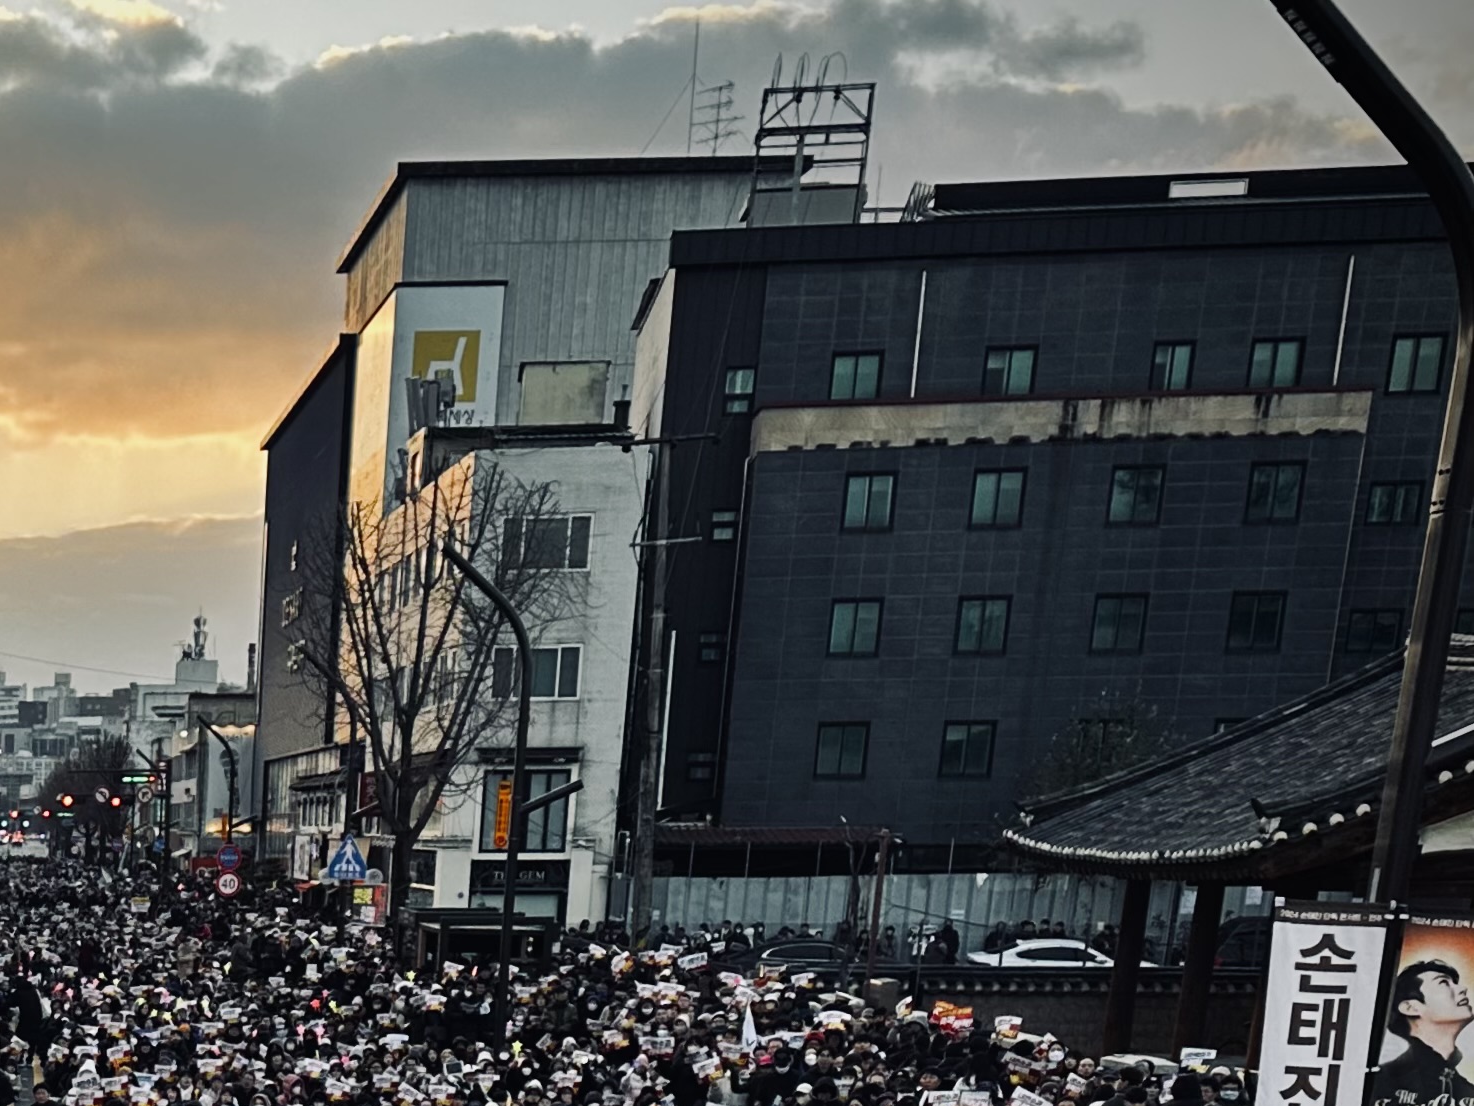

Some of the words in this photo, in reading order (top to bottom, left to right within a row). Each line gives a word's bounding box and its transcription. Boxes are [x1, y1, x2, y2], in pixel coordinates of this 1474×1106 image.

[519, 870, 545, 880] GEM
[221, 878, 236, 890] 40
[1279, 909, 1299, 919] 2024
[1394, 1088, 1419, 1105] THE
